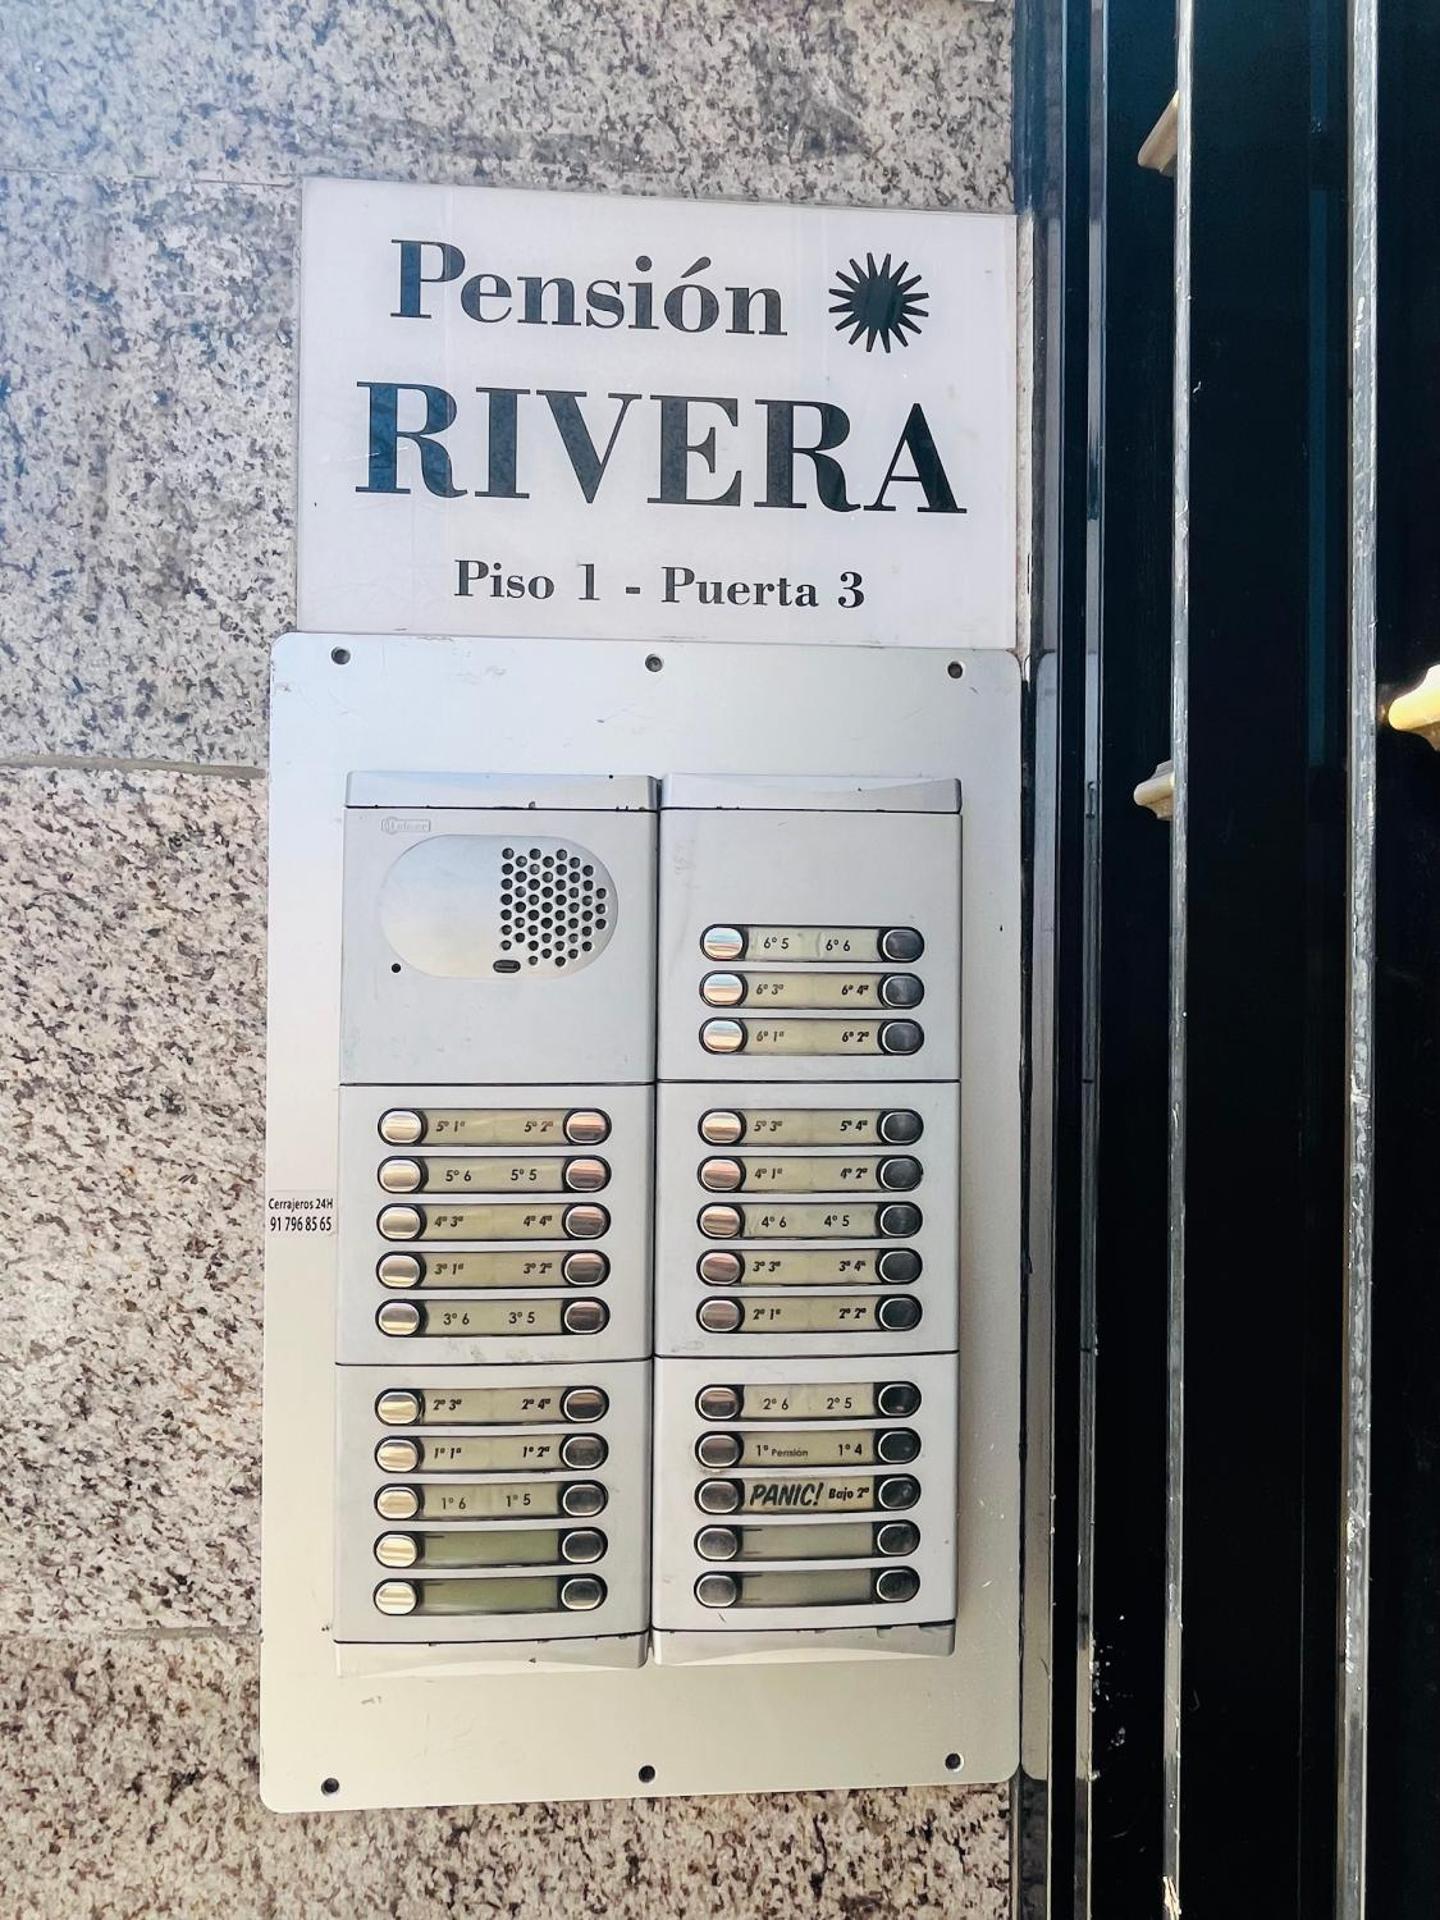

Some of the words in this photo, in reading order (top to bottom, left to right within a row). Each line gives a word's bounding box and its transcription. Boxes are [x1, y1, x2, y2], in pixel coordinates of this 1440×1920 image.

[391, 239, 787, 335] Pensión
[356, 381, 967, 514] RIVERA
[455, 559, 555, 599] Piso
[578, 562, 600, 601] 1
[661, 566, 818, 608] Puerta
[838, 571, 864, 609] 3
[781, 938, 789, 949] 5
[842, 940, 850, 951] 6
[463, 1170, 471, 1182] 6
[528, 1169, 537, 1181] 5
[268, 1198, 313, 1212] Cerrajeros
[315, 1198, 333, 1209] 24H
[269, 1217, 281, 1231] 91
[284, 1217, 303, 1231] 796
[305, 1217, 317, 1231] 85
[319, 1217, 331, 1231] 65
[779, 1217, 786, 1228] 6
[841, 1215, 849, 1227] 5
[461, 1314, 469, 1325] 6
[526, 1312, 535, 1323] 5
[780, 1399, 789, 1410] 6
[844, 1397, 852, 1408] 5
[770, 1448, 808, 1457] Pensión
[854, 1444, 862, 1455] 4
[522, 1494, 531, 1505] 5
[749, 1482, 824, 1506] PANIC!
[828, 1487, 853, 1500] Bajo
[458, 1497, 466, 1509] 6
